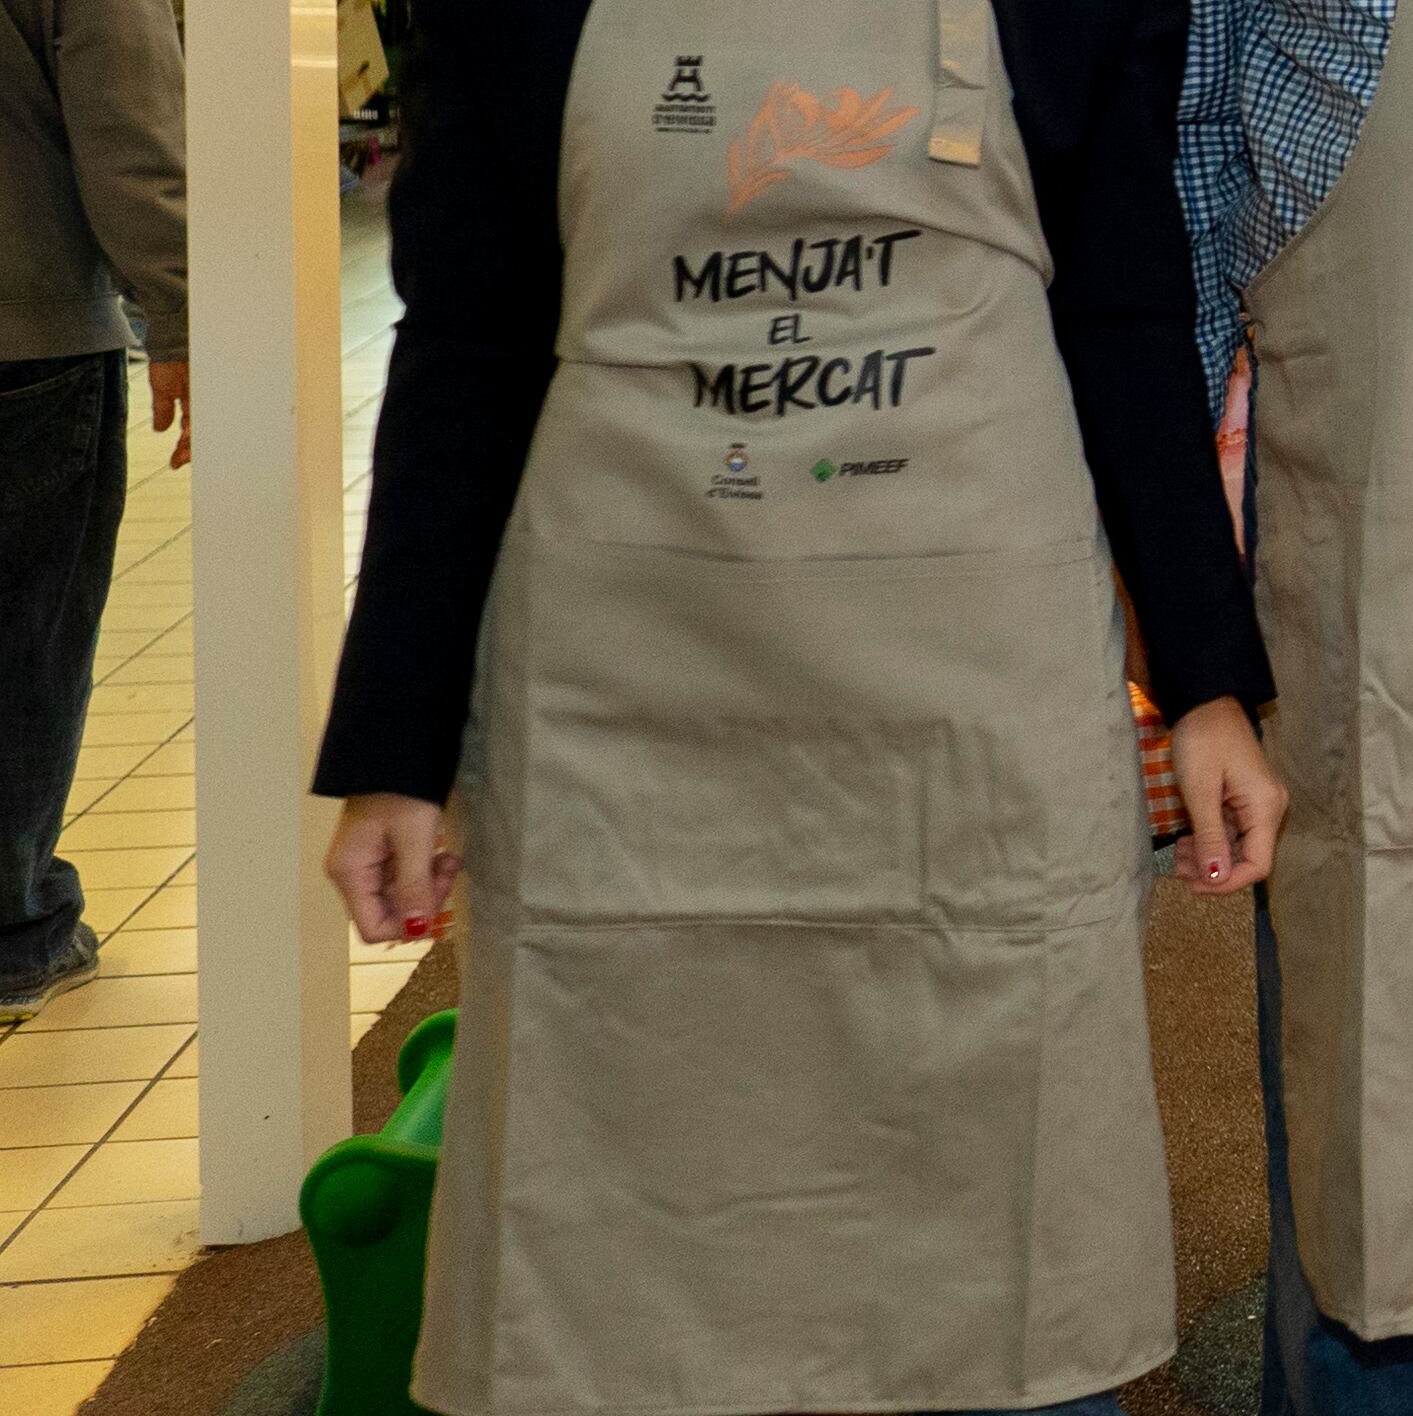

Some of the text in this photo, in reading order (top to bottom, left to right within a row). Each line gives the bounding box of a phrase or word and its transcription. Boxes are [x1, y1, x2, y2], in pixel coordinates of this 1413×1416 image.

[673, 229, 922, 302] MENJA'T
[767, 314, 813, 345] EL
[689, 347, 936, 416] MERCAT
[838, 458, 910, 476] PIMEEF
